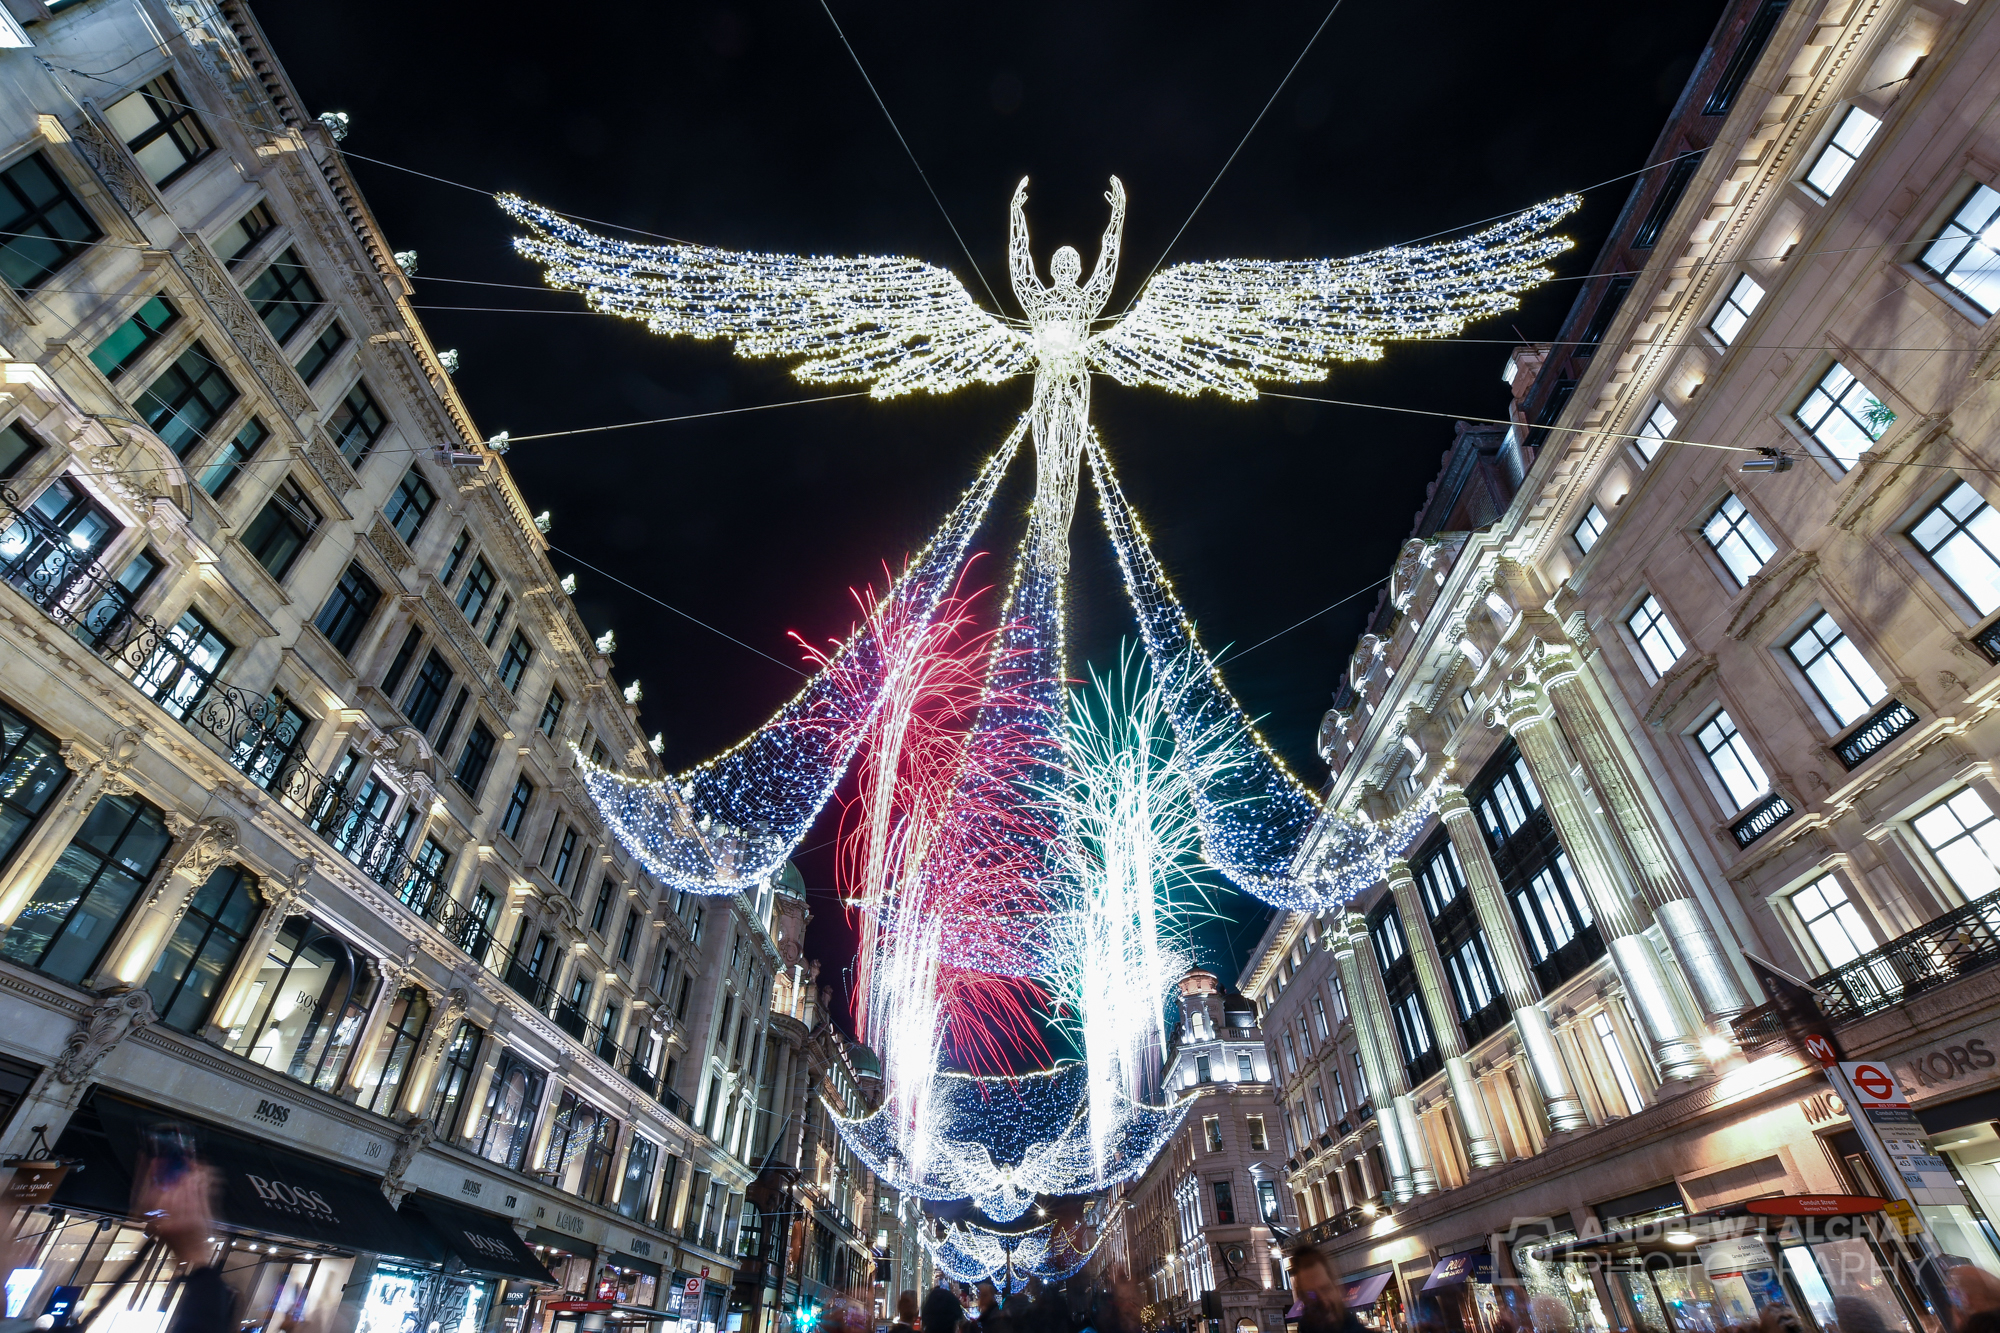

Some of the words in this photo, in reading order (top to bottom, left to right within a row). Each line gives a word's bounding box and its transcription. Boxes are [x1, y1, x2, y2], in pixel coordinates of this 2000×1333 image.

[295, 991, 324, 1015] BOSS
[1807, 1038, 1834, 1058] M
[1908, 1039, 1995, 1087] KORS
[256, 1100, 290, 1123] BOSS
[364, 1141, 382, 1158] 180
[11, 1182, 28, 1190] kate
[28, 1182, 53, 1192] spade
[245, 1174, 332, 1214] BOSS
[463, 1178, 482, 1194] BOSS
[264, 1200, 300, 1214] HUGO
[308, 1210, 340, 1224] BOSS
[506, 1195, 518, 1208] 178
[463, 1231, 514, 1256] BOSS
